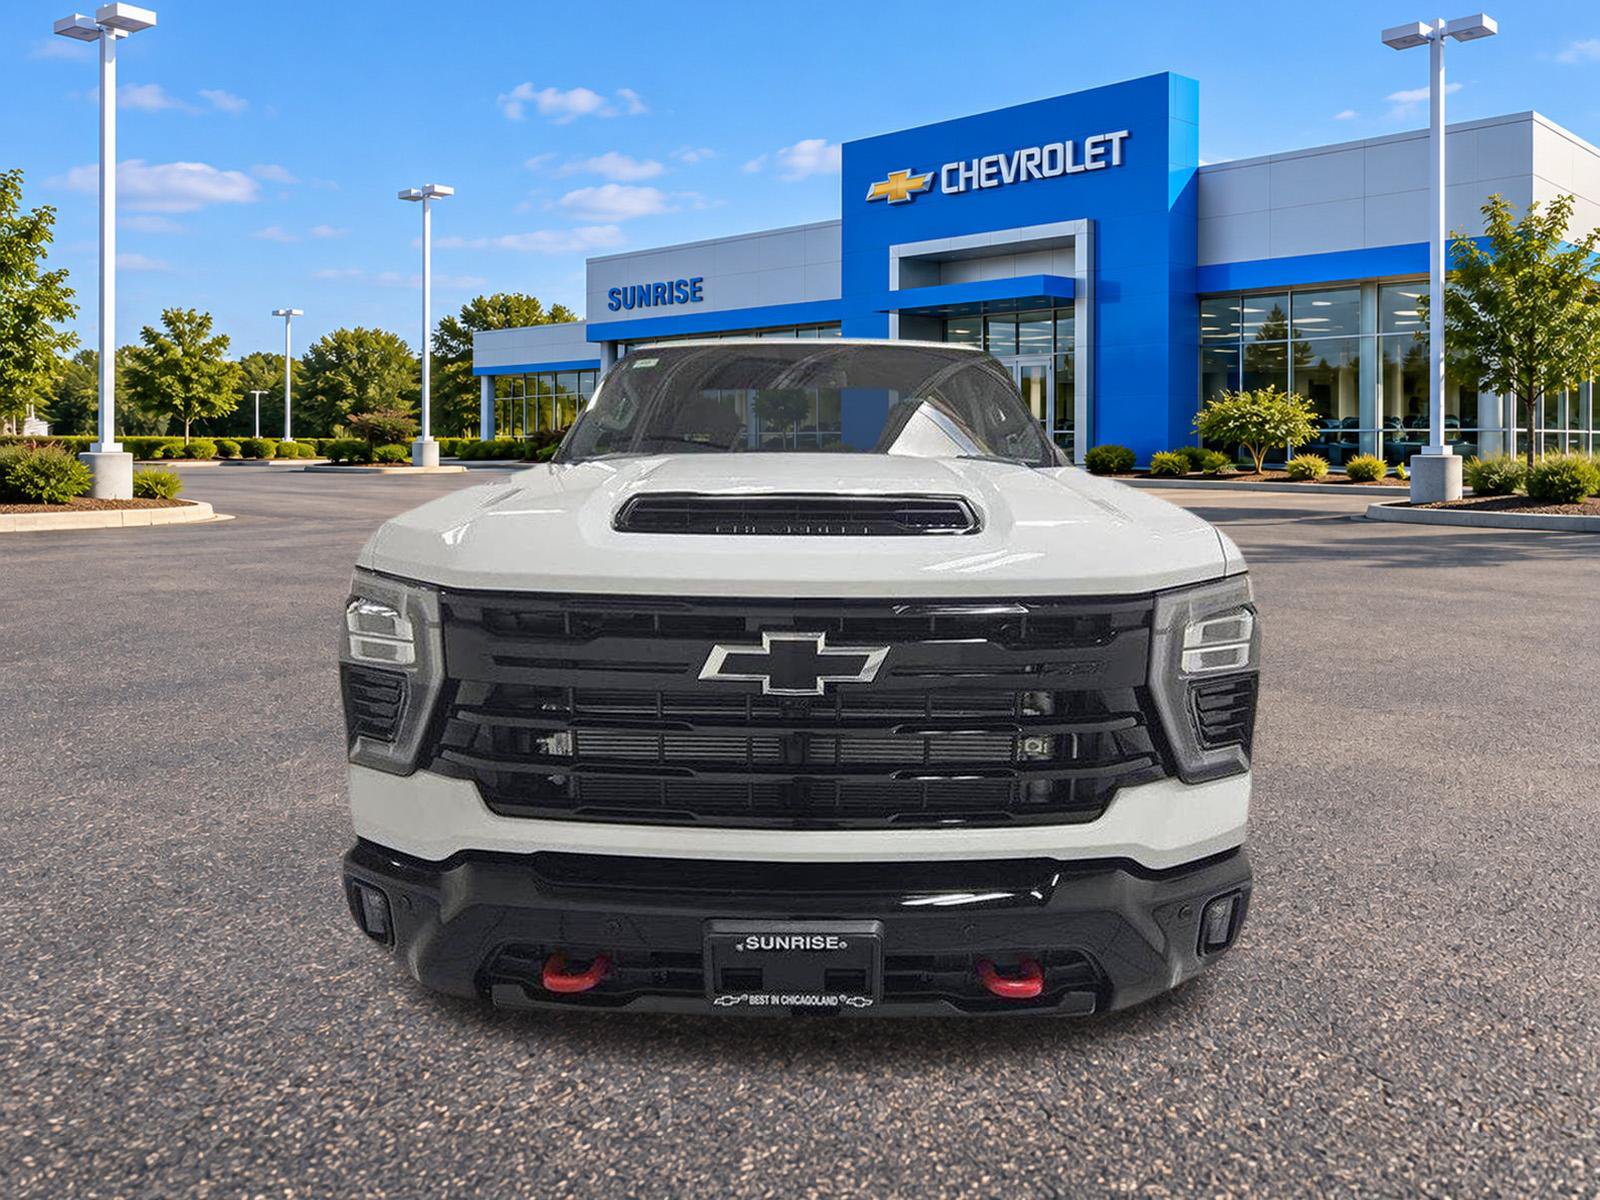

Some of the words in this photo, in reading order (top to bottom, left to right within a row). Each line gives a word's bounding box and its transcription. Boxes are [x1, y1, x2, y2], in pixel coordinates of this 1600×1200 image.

[940, 130, 1129, 194] CHEVROLET
[608, 277, 704, 312] SUNRISE
[746, 936, 839, 950] SUNRISE
[749, 995, 770, 1006] BEST
[771, 995, 780, 1005] IN
[780, 995, 839, 1006] CHICAGOLAND
